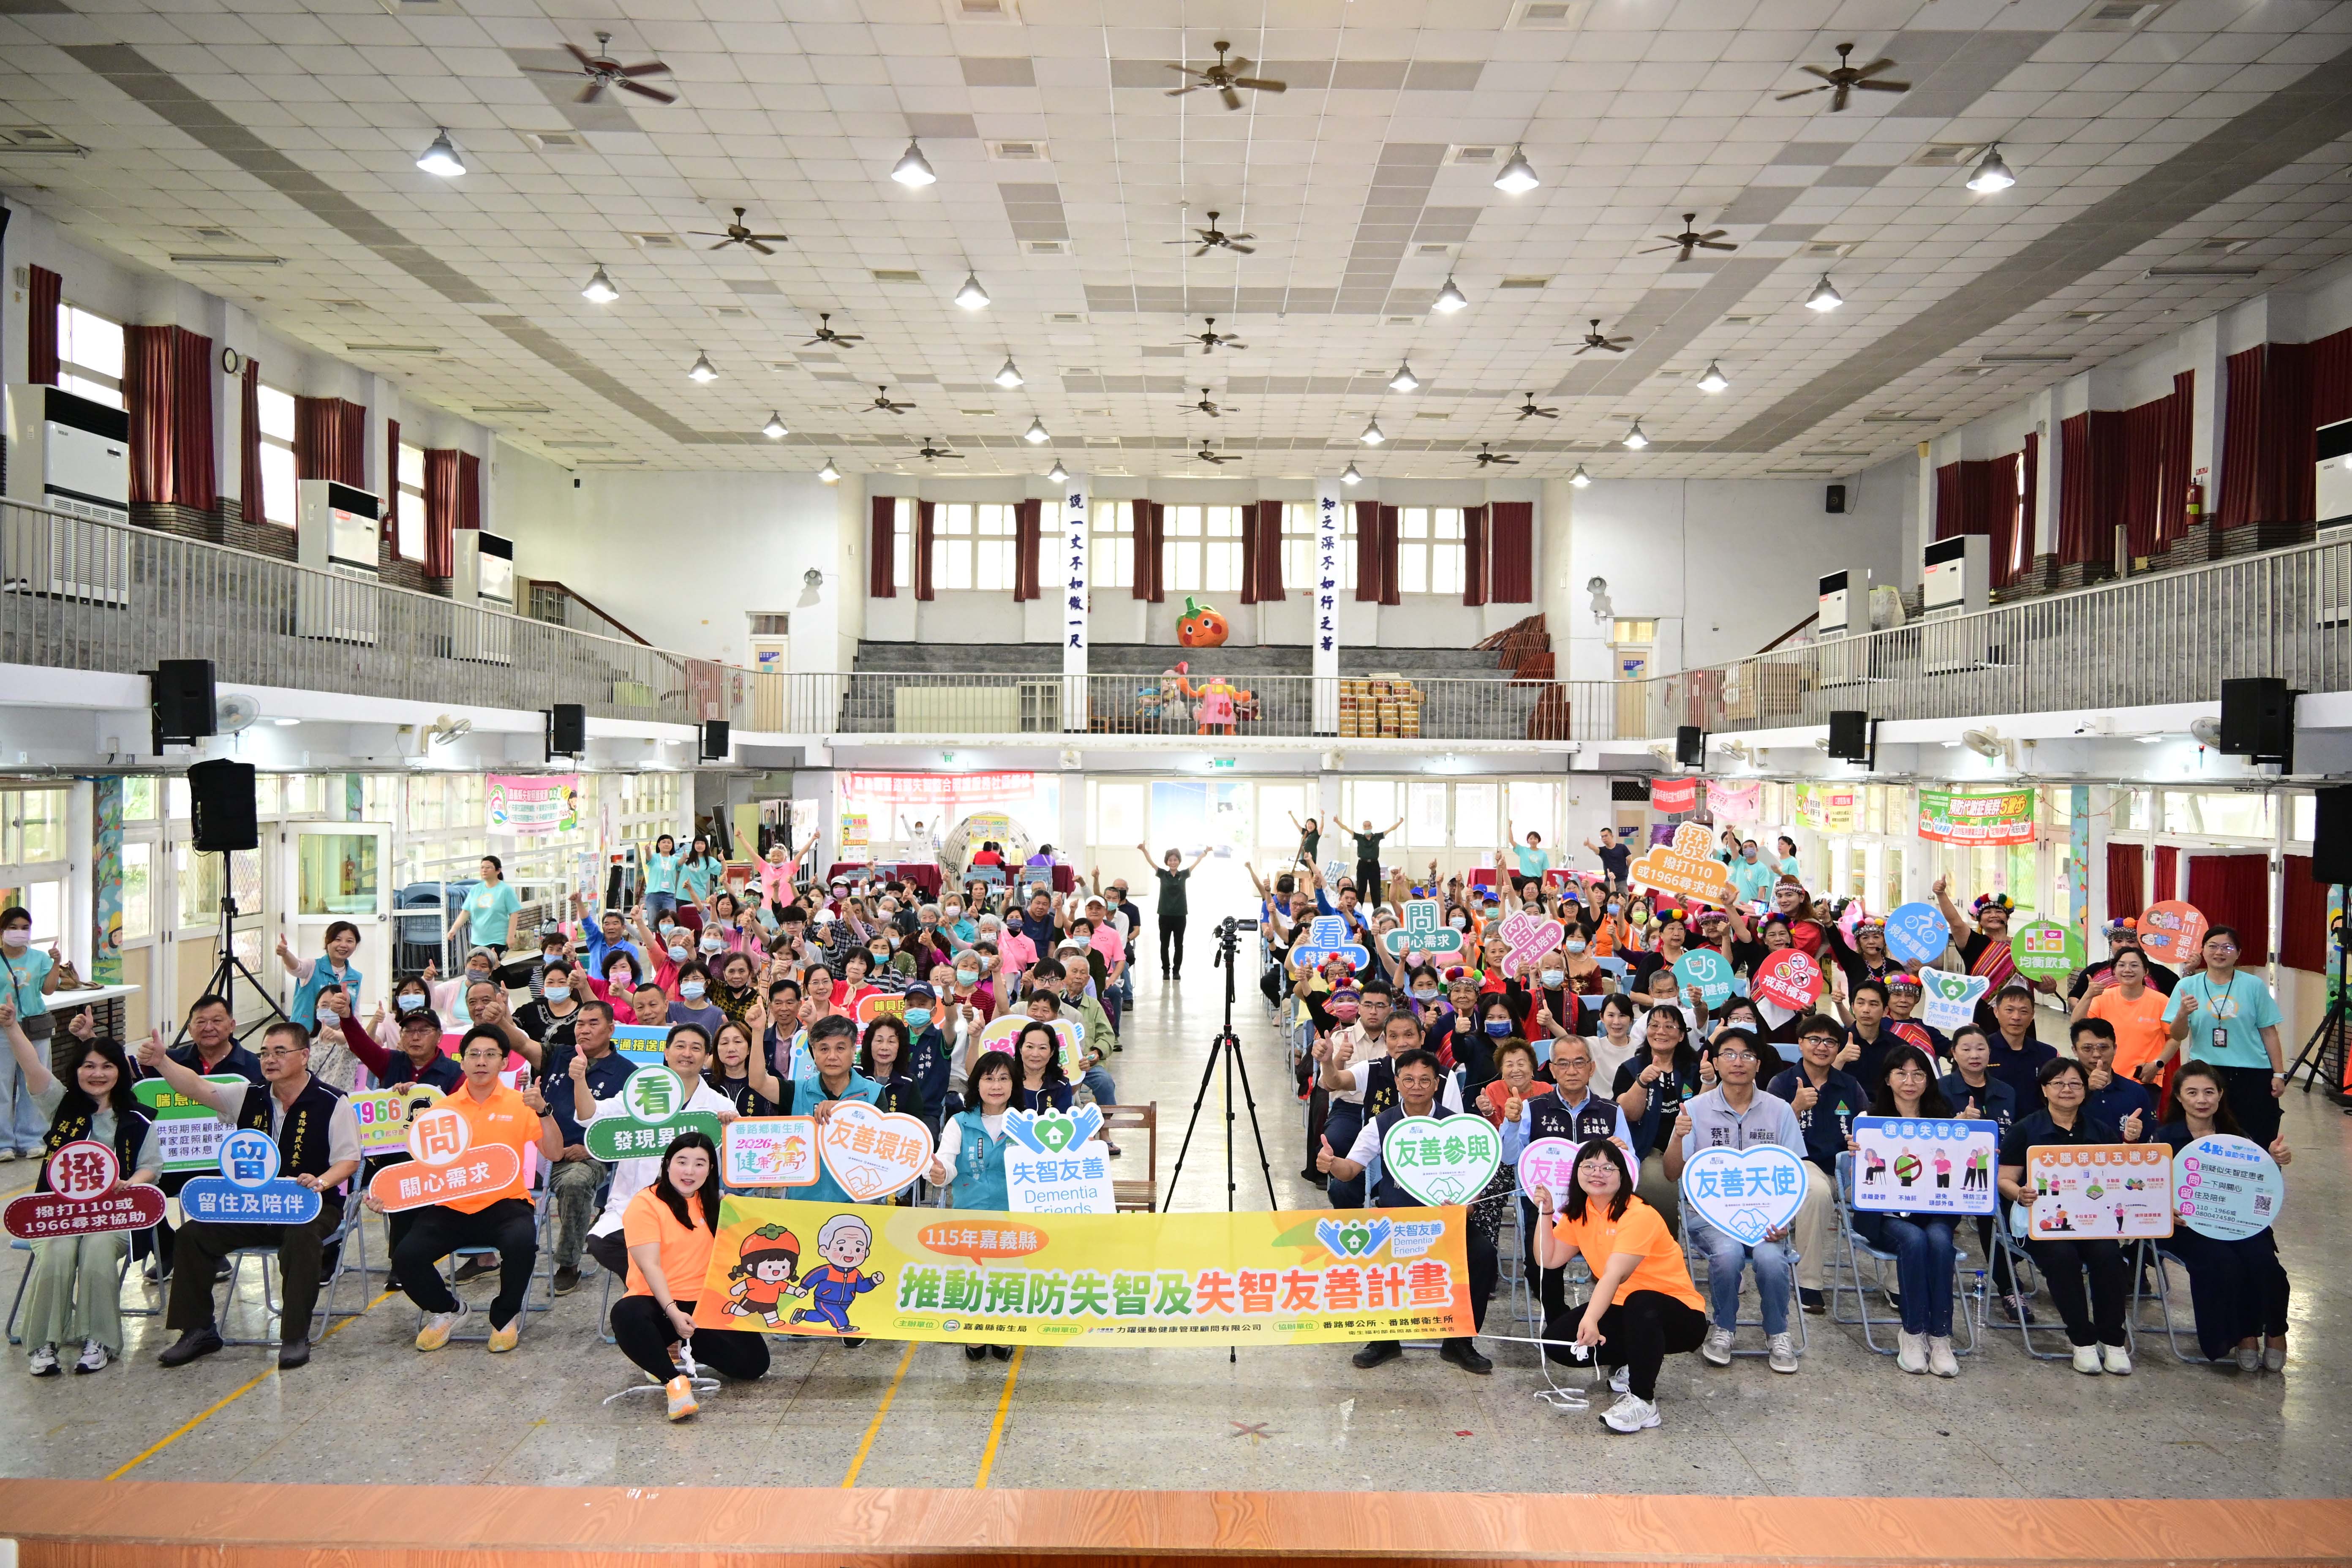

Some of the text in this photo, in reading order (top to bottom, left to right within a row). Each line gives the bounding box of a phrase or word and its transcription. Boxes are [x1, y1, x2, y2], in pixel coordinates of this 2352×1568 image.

[1674, 825, 1712, 862] 撥
[1663, 856, 1712, 879] 撥打110
[1407, 904, 1435, 933] 問
[1314, 918, 1342, 949] 看
[1397, 934, 1450, 949] 關心需求
[1502, 913, 1534, 949] 留
[1888, 923, 1931, 961] 規律運動
[1304, 951, 1356, 964] 發現狀
[2019, 956, 2072, 969] 均衡飲食
[1927, 1012, 1958, 1022] Dementia
[1928, 1001, 1971, 1017] 失智友善
[1926, 1017, 1951, 1028] Friends
[635, 1074, 673, 1116] 看
[353, 1099, 402, 1124] 1966
[157, 1122, 236, 1135] 供短期照顧服務
[418, 1114, 461, 1161] 問
[735, 1122, 805, 1135] 番路鄉衛生所
[1749, 1131, 1775, 1140] 陳冠廷
[1885, 1124, 1966, 1138] 遠離失智症
[168, 1147, 213, 1157] 獲得休息
[827, 1117, 923, 1168] 友善環境
[1395, 1135, 1492, 1168] 友善參與
[2199, 1141, 2224, 1156] 4點
[231, 1140, 268, 1180] 留
[1013, 1156, 1105, 1186] 失智友善
[59, 1151, 106, 1193] 撥
[400, 1161, 491, 1200] 關心需求
[1695, 1165, 1798, 1199] 友善天使
[198, 1192, 304, 1214] 留住及陪伴
[1024, 1185, 1098, 1204] Dementia
[2194, 1192, 2227, 1203] 住及陪伴
[35, 1197, 135, 1219] 撥打110或
[2195, 1210, 2236, 1222] 0800474580
[25, 1210, 147, 1234] 1966尋求協助
[1394, 1223, 1443, 1237] 失智友善
[926, 1228, 1038, 1251] 115年嘉義縣
[1394, 1237, 1433, 1246] Dementia
[1394, 1246, 1425, 1255] Friends
[899, 1262, 1449, 1316] 推動預防失智及失智友善計畫
[898, 1320, 934, 1328] 主辦單位
[963, 1323, 1027, 1333] 嘉義縣衛生局
[1042, 1326, 1078, 1334] 承辦單位
[1116, 1323, 1261, 1333] 力躍運動健康管理顧問有限公司
[1323, 1314, 1454, 1329] 番路鄉公所、番路鄉衛生所
[1348, 1328, 1437, 1336] 衛生福利部長照基金獎助
